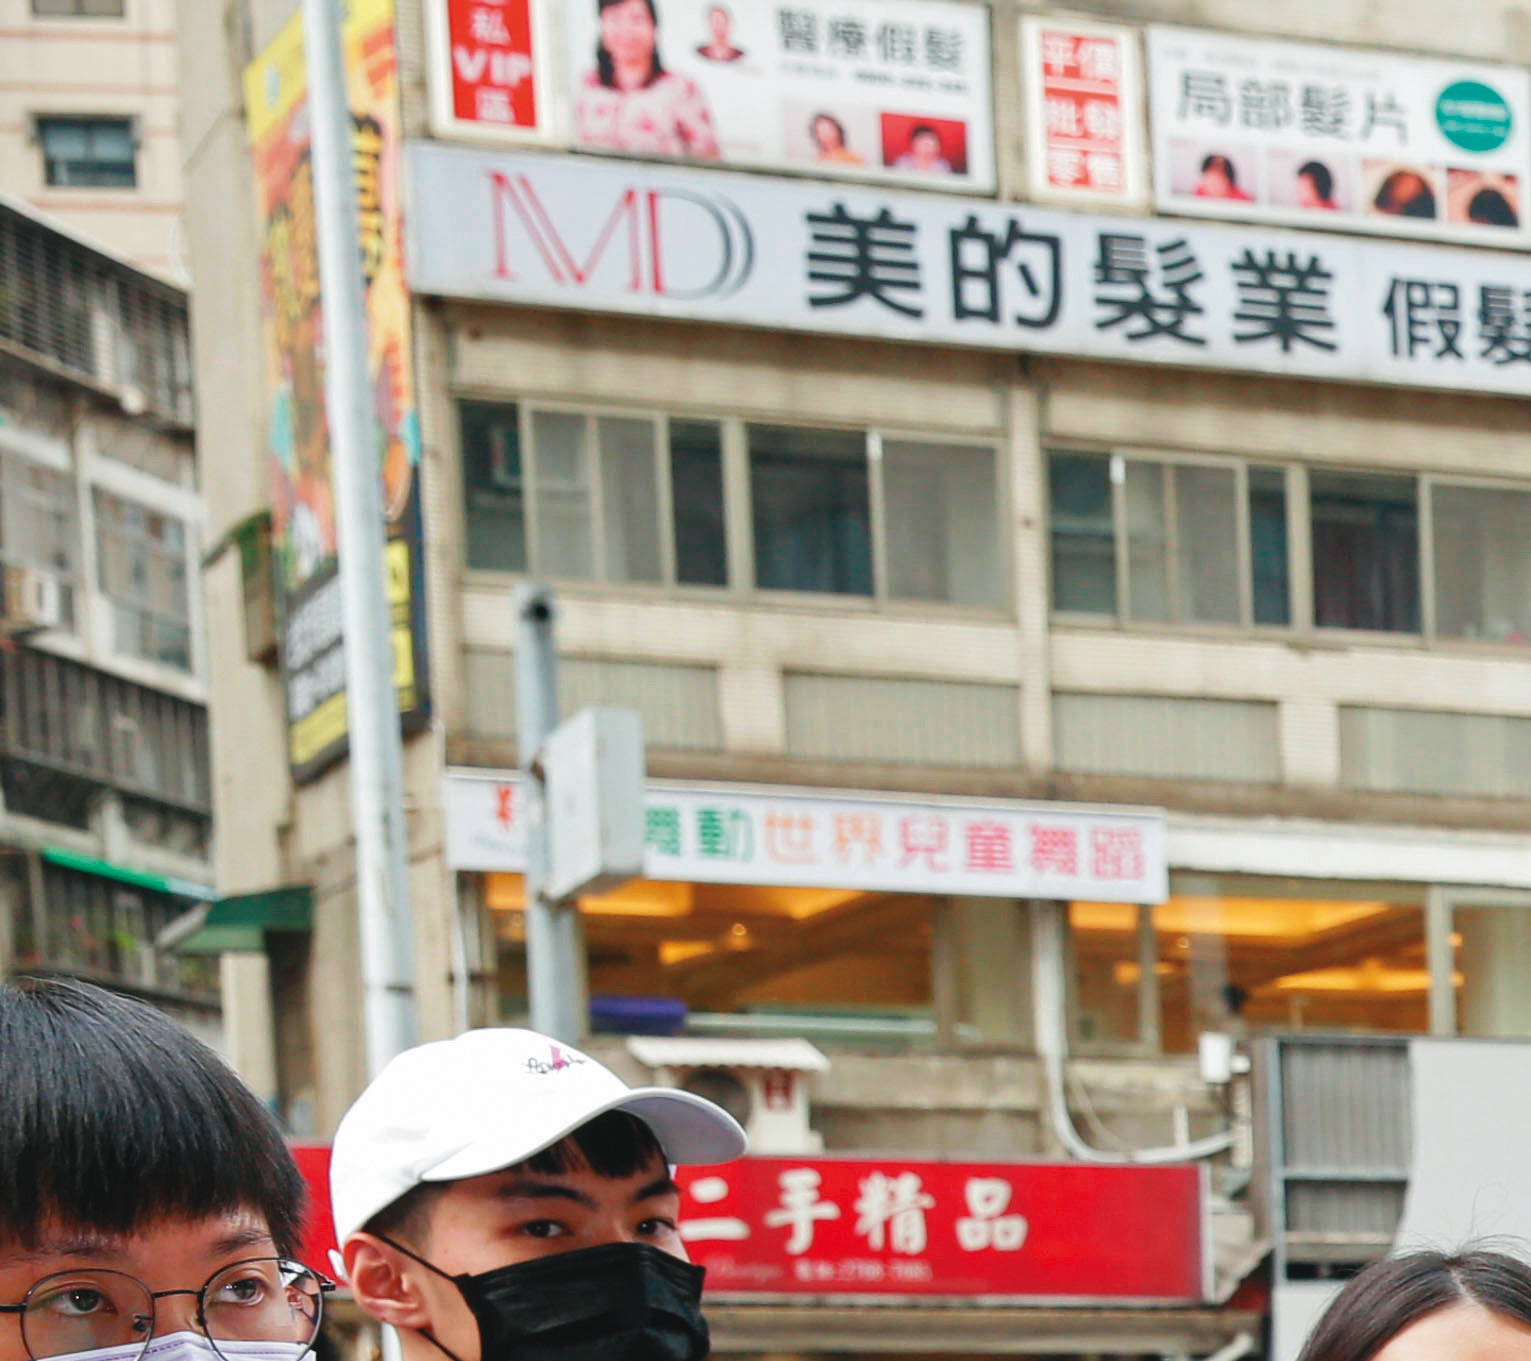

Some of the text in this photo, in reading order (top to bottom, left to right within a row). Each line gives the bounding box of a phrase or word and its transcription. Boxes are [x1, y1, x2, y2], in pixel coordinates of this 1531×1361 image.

[453, 44, 533, 87] VIP
[780, 8, 966, 69] 醫療假髮
[1178, 68, 1408, 146] 局部髮片
[805, 205, 1338, 352] 美的髮業
[679, 1167, 1030, 1256] 二手精品
